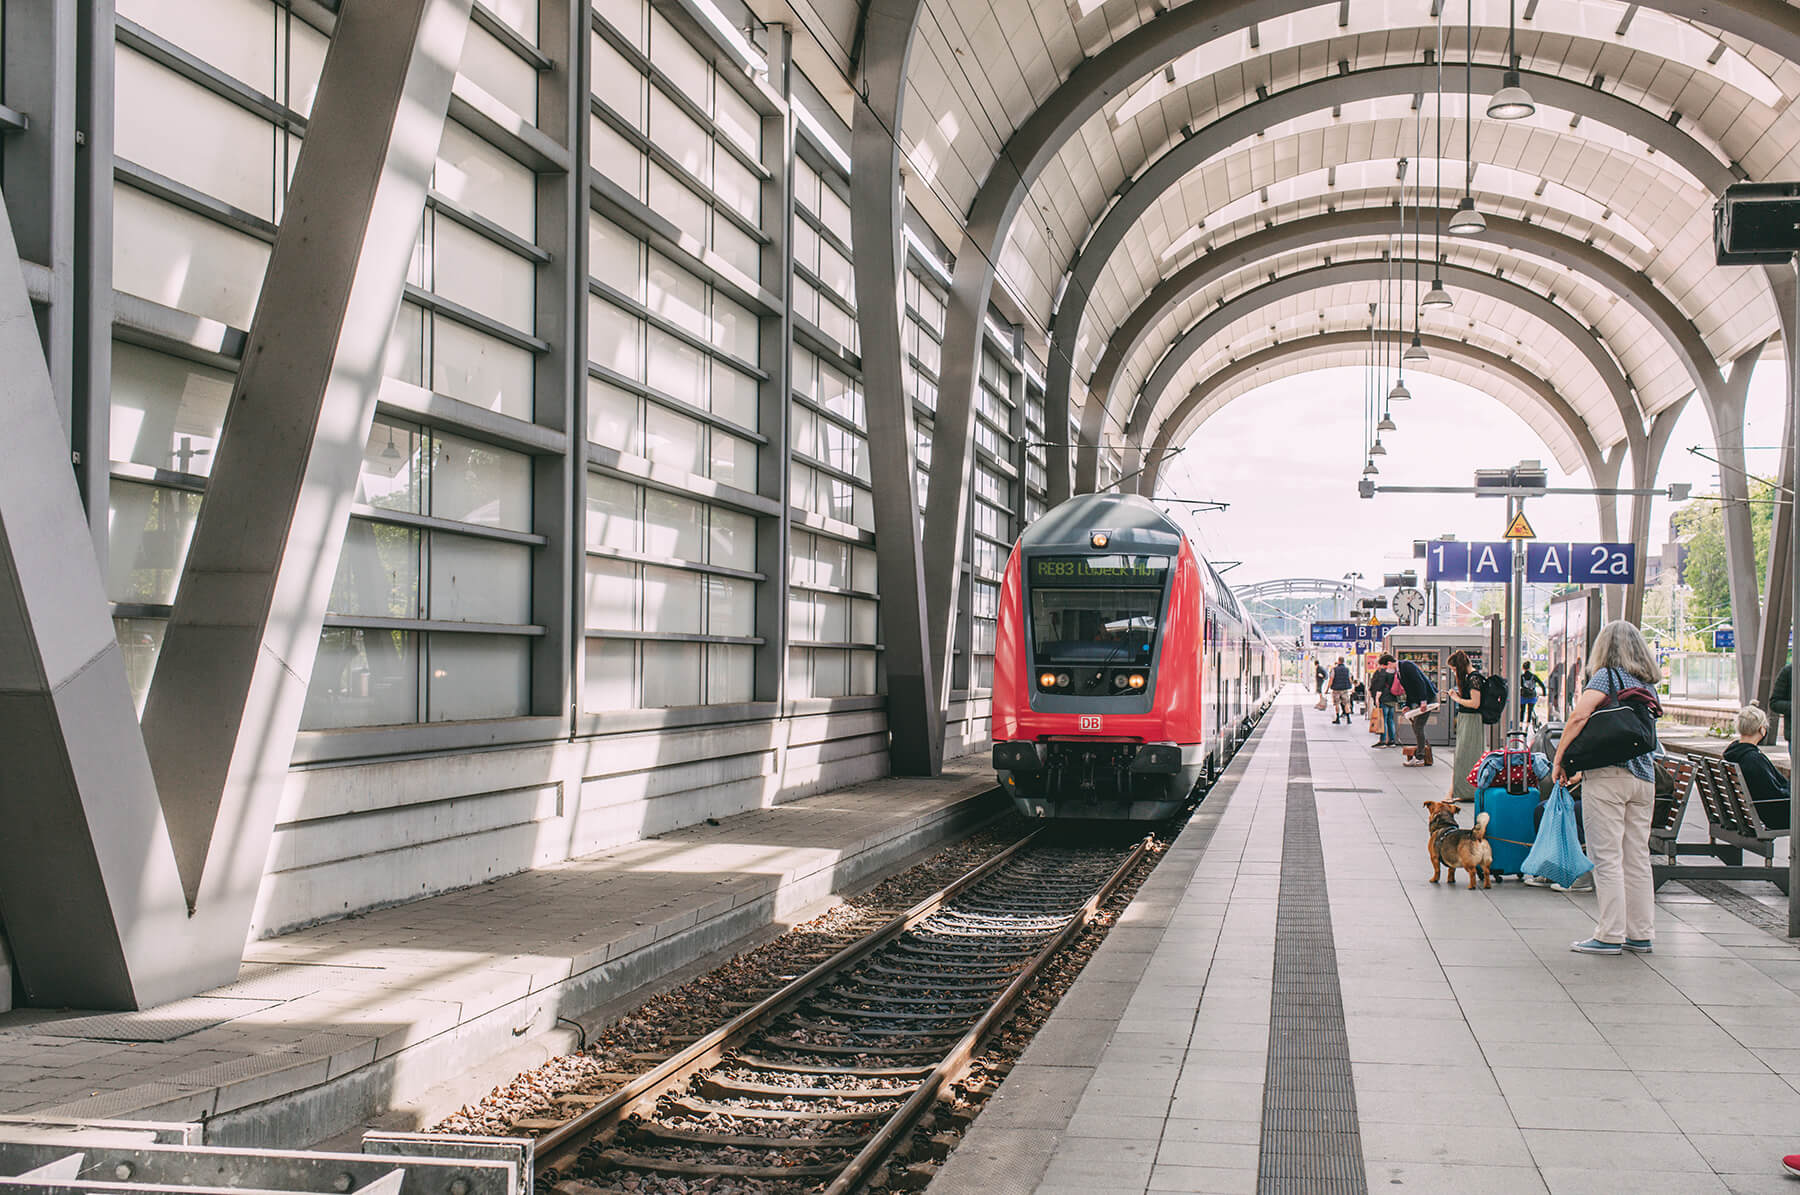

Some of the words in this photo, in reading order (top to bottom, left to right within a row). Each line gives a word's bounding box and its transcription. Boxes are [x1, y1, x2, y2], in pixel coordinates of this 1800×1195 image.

[1432, 544, 1444, 573] 1
[1475, 545, 1499, 573] A
[1539, 546, 1563, 574] A
[1589, 546, 1629, 575] 2a
[1038, 561, 1074, 576] RE83
[1343, 627, 1349, 637] 1
[1358, 627, 1367, 637] B
[1082, 717, 1100, 729] DB
